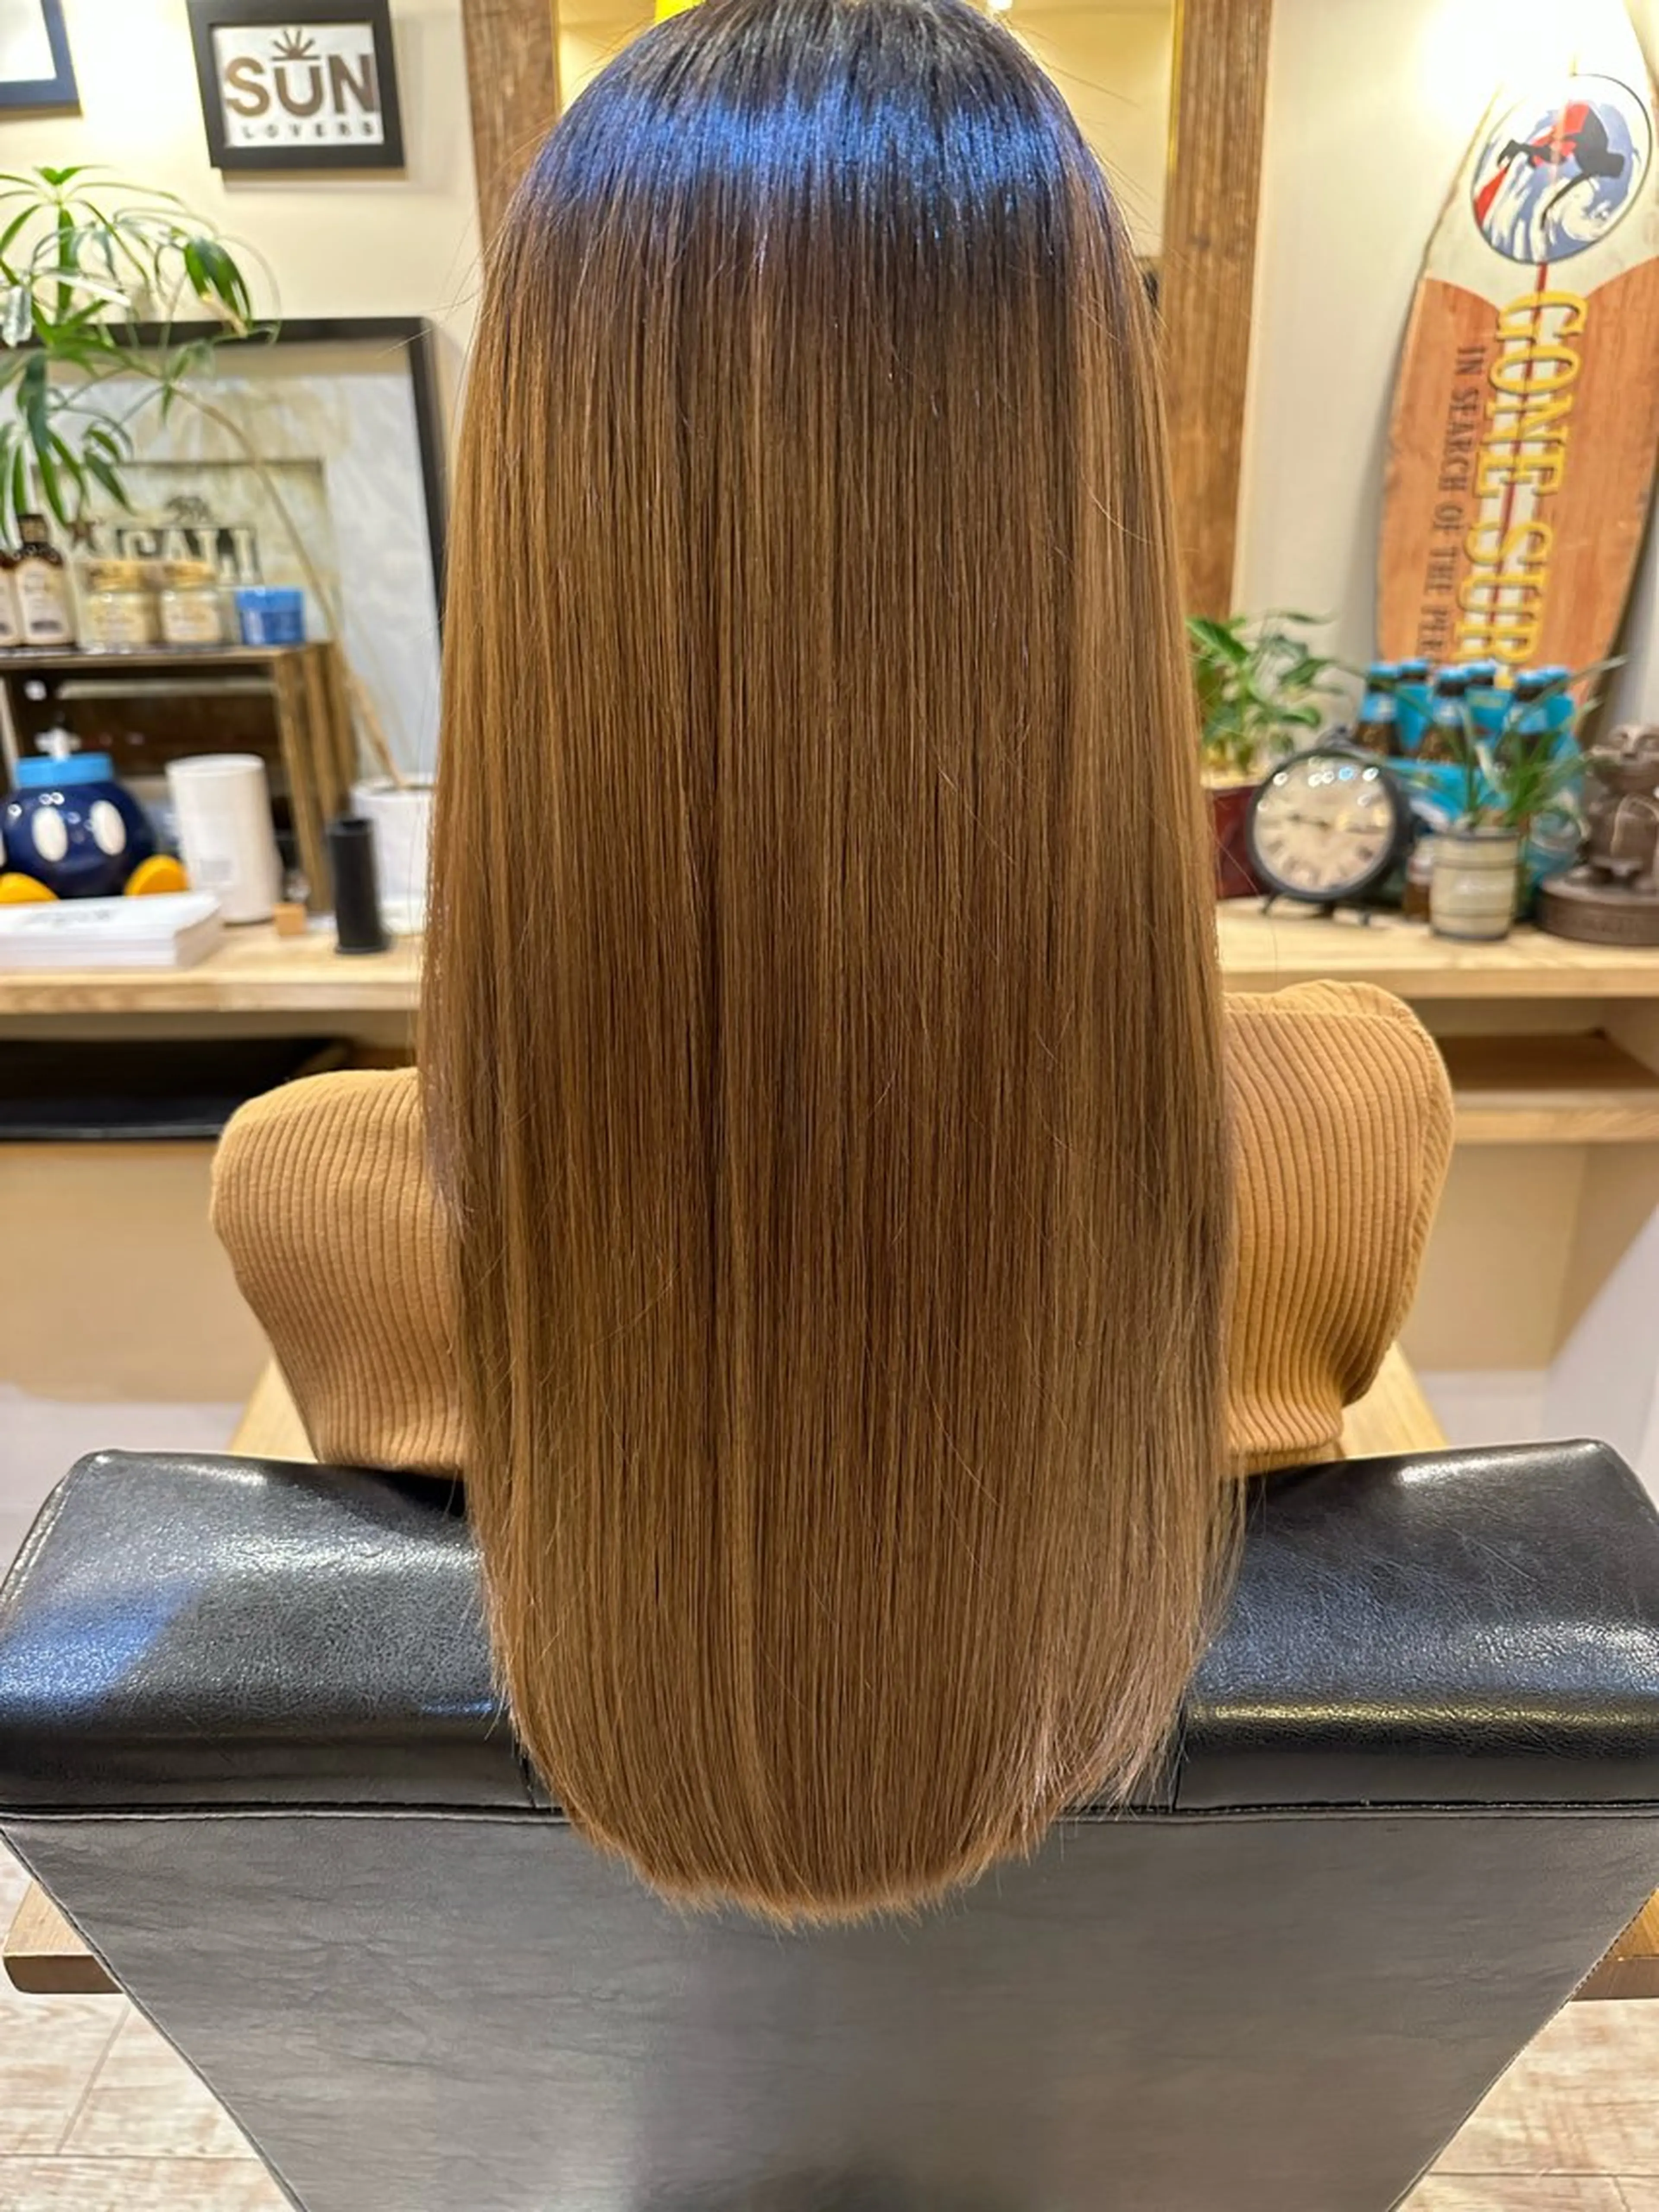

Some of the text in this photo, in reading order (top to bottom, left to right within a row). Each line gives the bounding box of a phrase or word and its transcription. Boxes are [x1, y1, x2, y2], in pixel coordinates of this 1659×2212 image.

[227, 54, 378, 117] SUN
[241, 122, 374, 139] LOVERS
[1456, 346, 1485, 375] IN
[1438, 386, 1478, 491] SEARCH
[1449, 292, 1588, 690] GONE SUR
[1433, 501, 1464, 531] OF
[1425, 547, 1457, 595] THE
